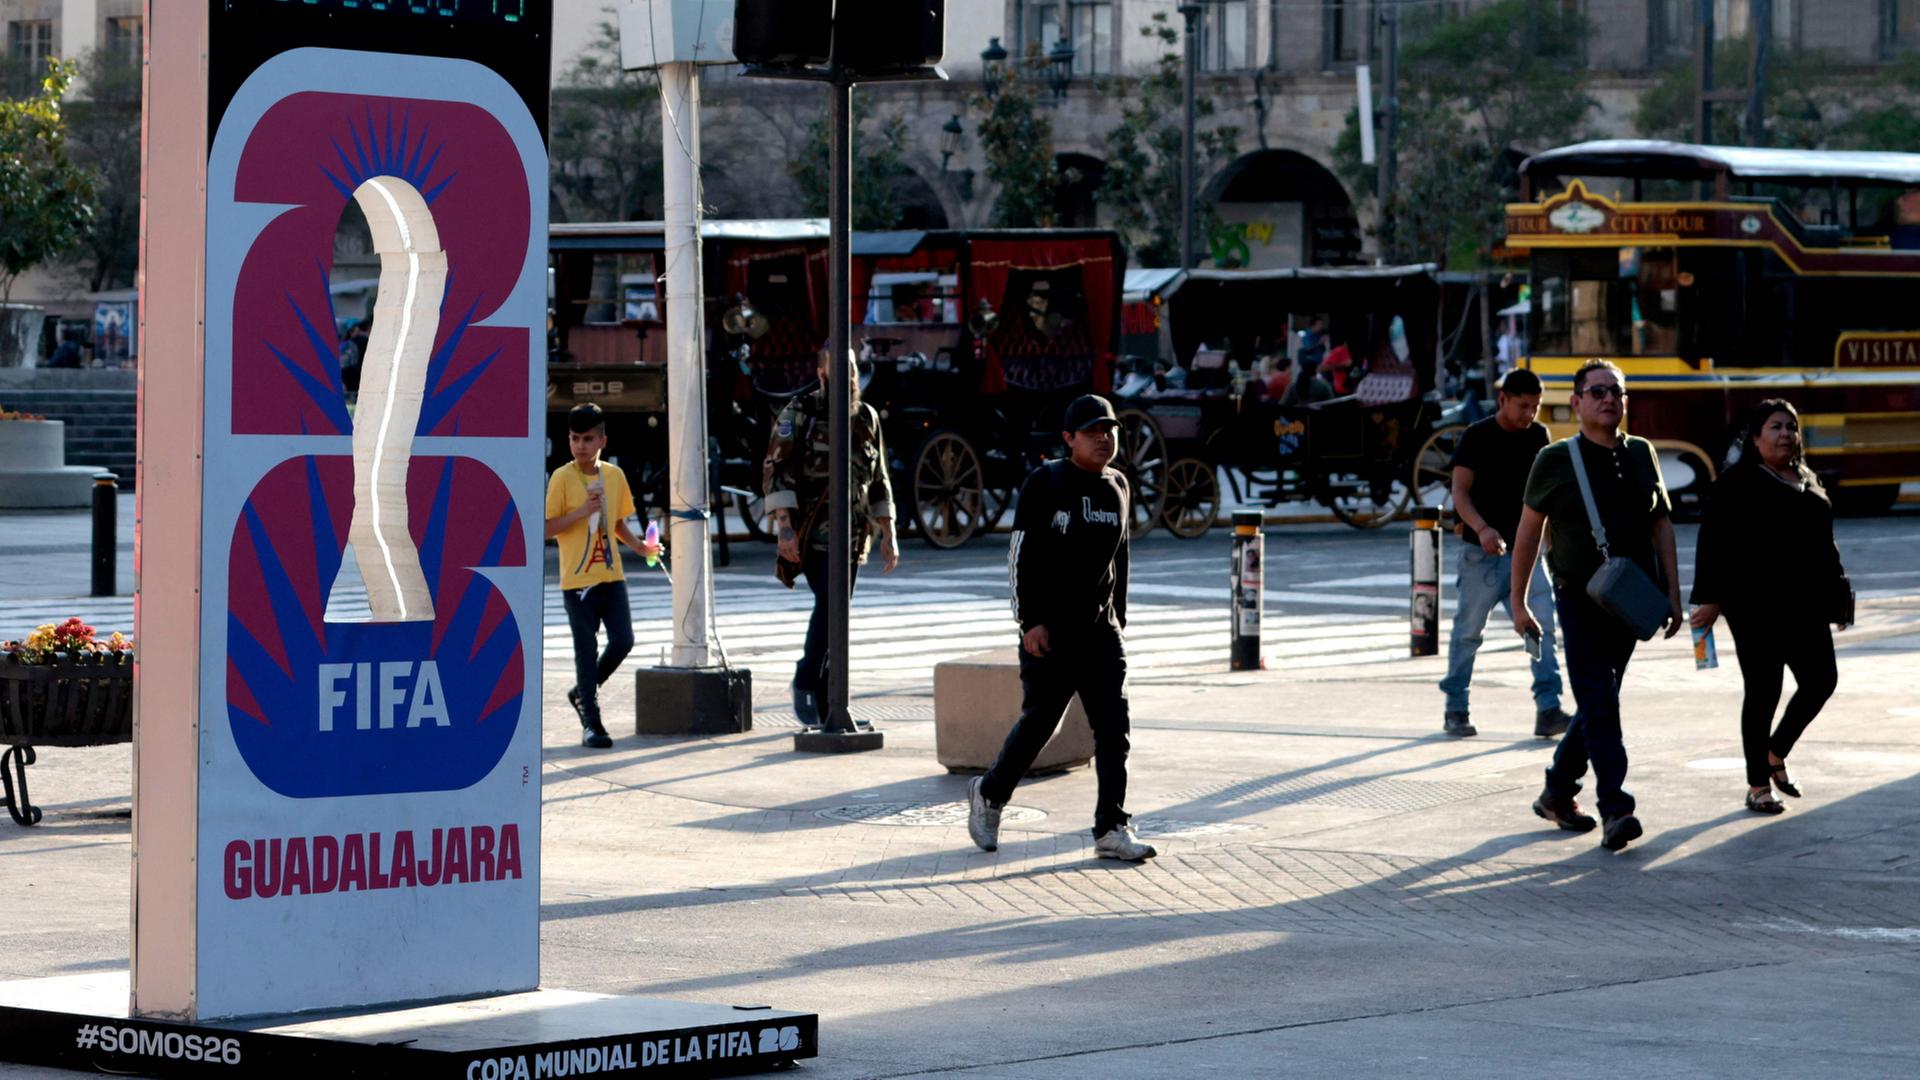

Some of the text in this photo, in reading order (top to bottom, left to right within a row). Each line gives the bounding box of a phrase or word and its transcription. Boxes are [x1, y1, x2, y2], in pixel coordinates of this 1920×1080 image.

[1611, 216, 1705, 231] CITY TOUR
[1848, 341, 1917, 363] VISITA
[318, 660, 451, 732] FIFA
[223, 824, 522, 900] GUADALAJARA
[76, 1024, 241, 1065] #SOMOS26
[466, 1025, 799, 1080] COPA MUNDIAL DE LA FIFA 26
